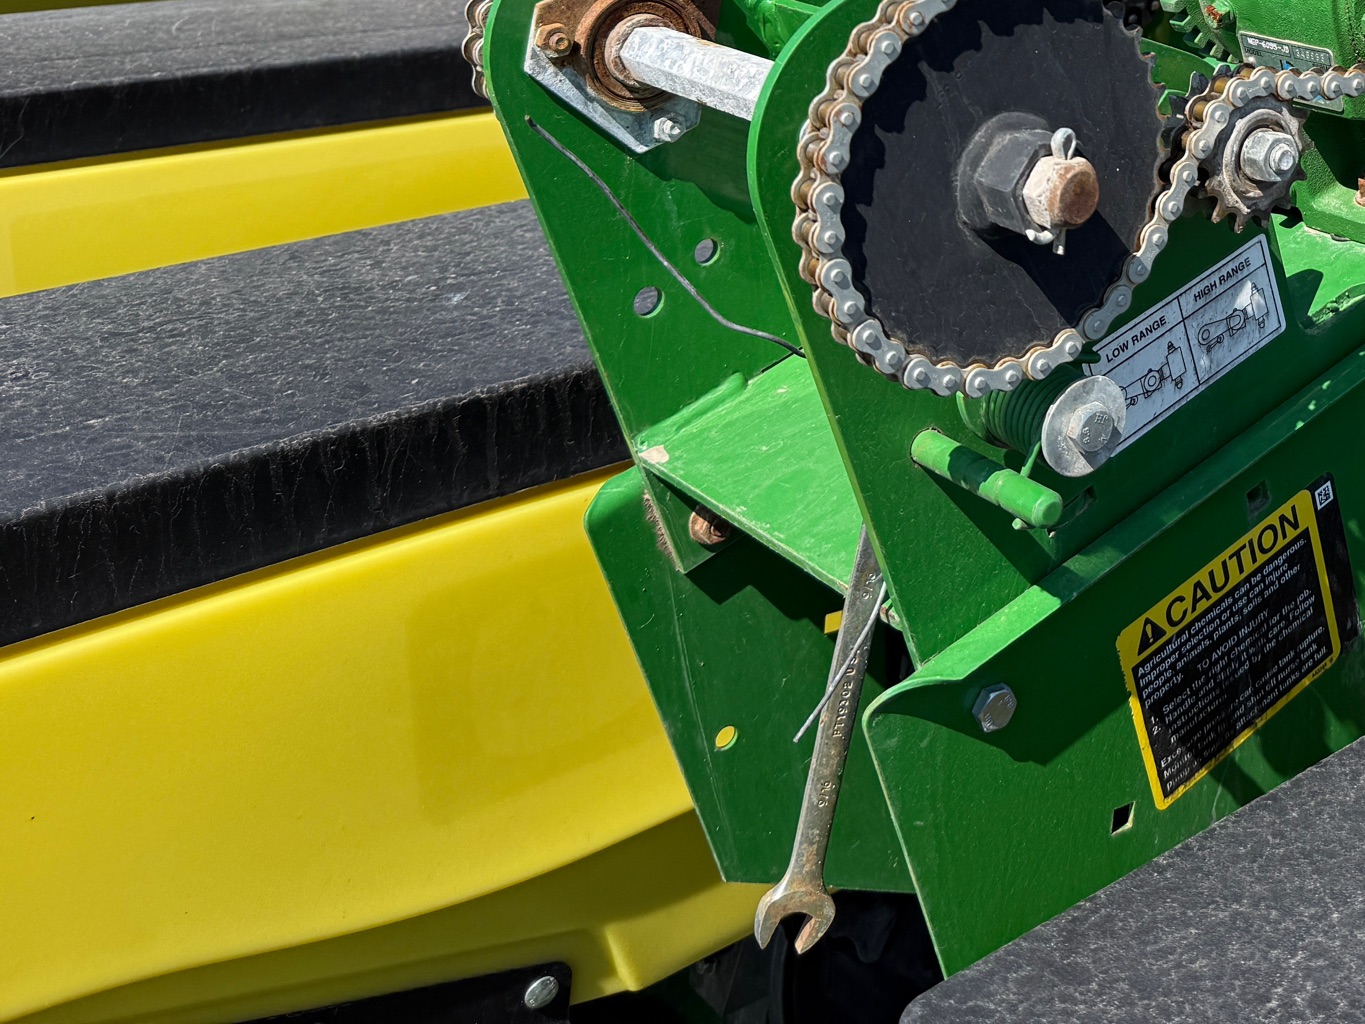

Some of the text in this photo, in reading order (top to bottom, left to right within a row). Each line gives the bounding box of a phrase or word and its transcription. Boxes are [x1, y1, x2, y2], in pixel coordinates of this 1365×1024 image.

[1193, 256, 1252, 303] HIGH RANGE
[1105, 314, 1168, 364] LOW RANGE
[1165, 503, 1300, 628] CAUTION
[1137, 538, 1306, 677] Agricultural chemicals can be dangerous.
[1139, 562, 1288, 687] Improper selection or use can injure
[1142, 563, 1300, 699] people, animals, plants, soils and other
[1196, 609, 1268, 671] TO AVOID INJURY
[1222, 659, 1250, 688] iued
[1263, 638, 1276, 653] the
[1278, 605, 1313, 640] chemical
[1278, 649, 1295, 667] tank
[1296, 626, 1325, 652] rupture.
[1144, 672, 1184, 710] property.
[1150, 589, 1312, 724] 1. Select the right chemical for the job.
[1152, 725, 1161, 736] 2.
[1164, 695, 1196, 724] Handle
[1198, 678, 1214, 697] and
[1216, 660, 1239, 682] apply
[1241, 651, 1247, 661] it
[1289, 594, 1315, 620] Follow
[1234, 704, 1245, 718] nd
[1300, 643, 1317, 660] tank
[1301, 658, 1313, 673] are
